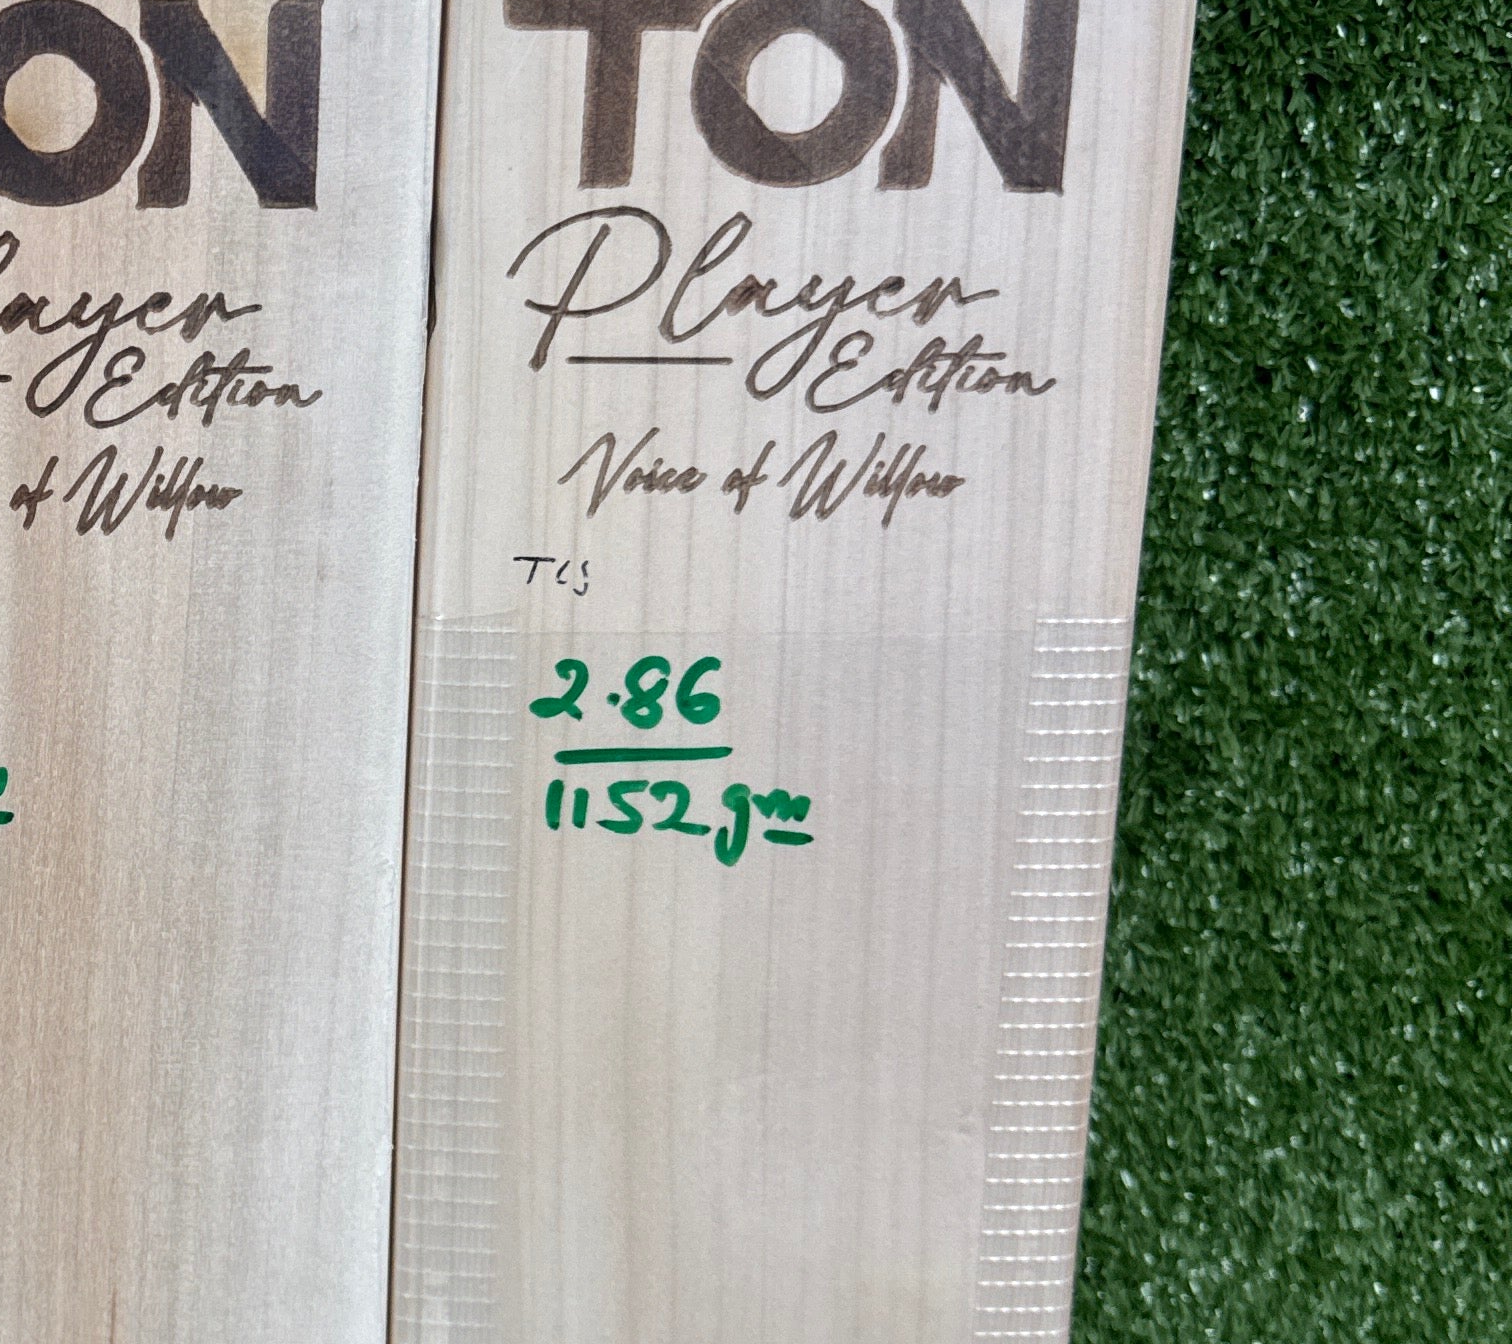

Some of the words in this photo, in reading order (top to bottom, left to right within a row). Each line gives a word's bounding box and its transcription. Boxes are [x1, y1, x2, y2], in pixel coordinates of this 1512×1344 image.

[507, 205, 1000, 401] Player
[84, 346, 323, 429] Edition
[806, 330, 1056, 414] Edition
[9, 455, 59, 530] of
[63, 444, 243, 541] Willow
[558, 427, 707, 519] Voice
[722, 440, 775, 514] of
[778, 430, 966, 528] Willow
[528, 655, 721, 729] 2.86
